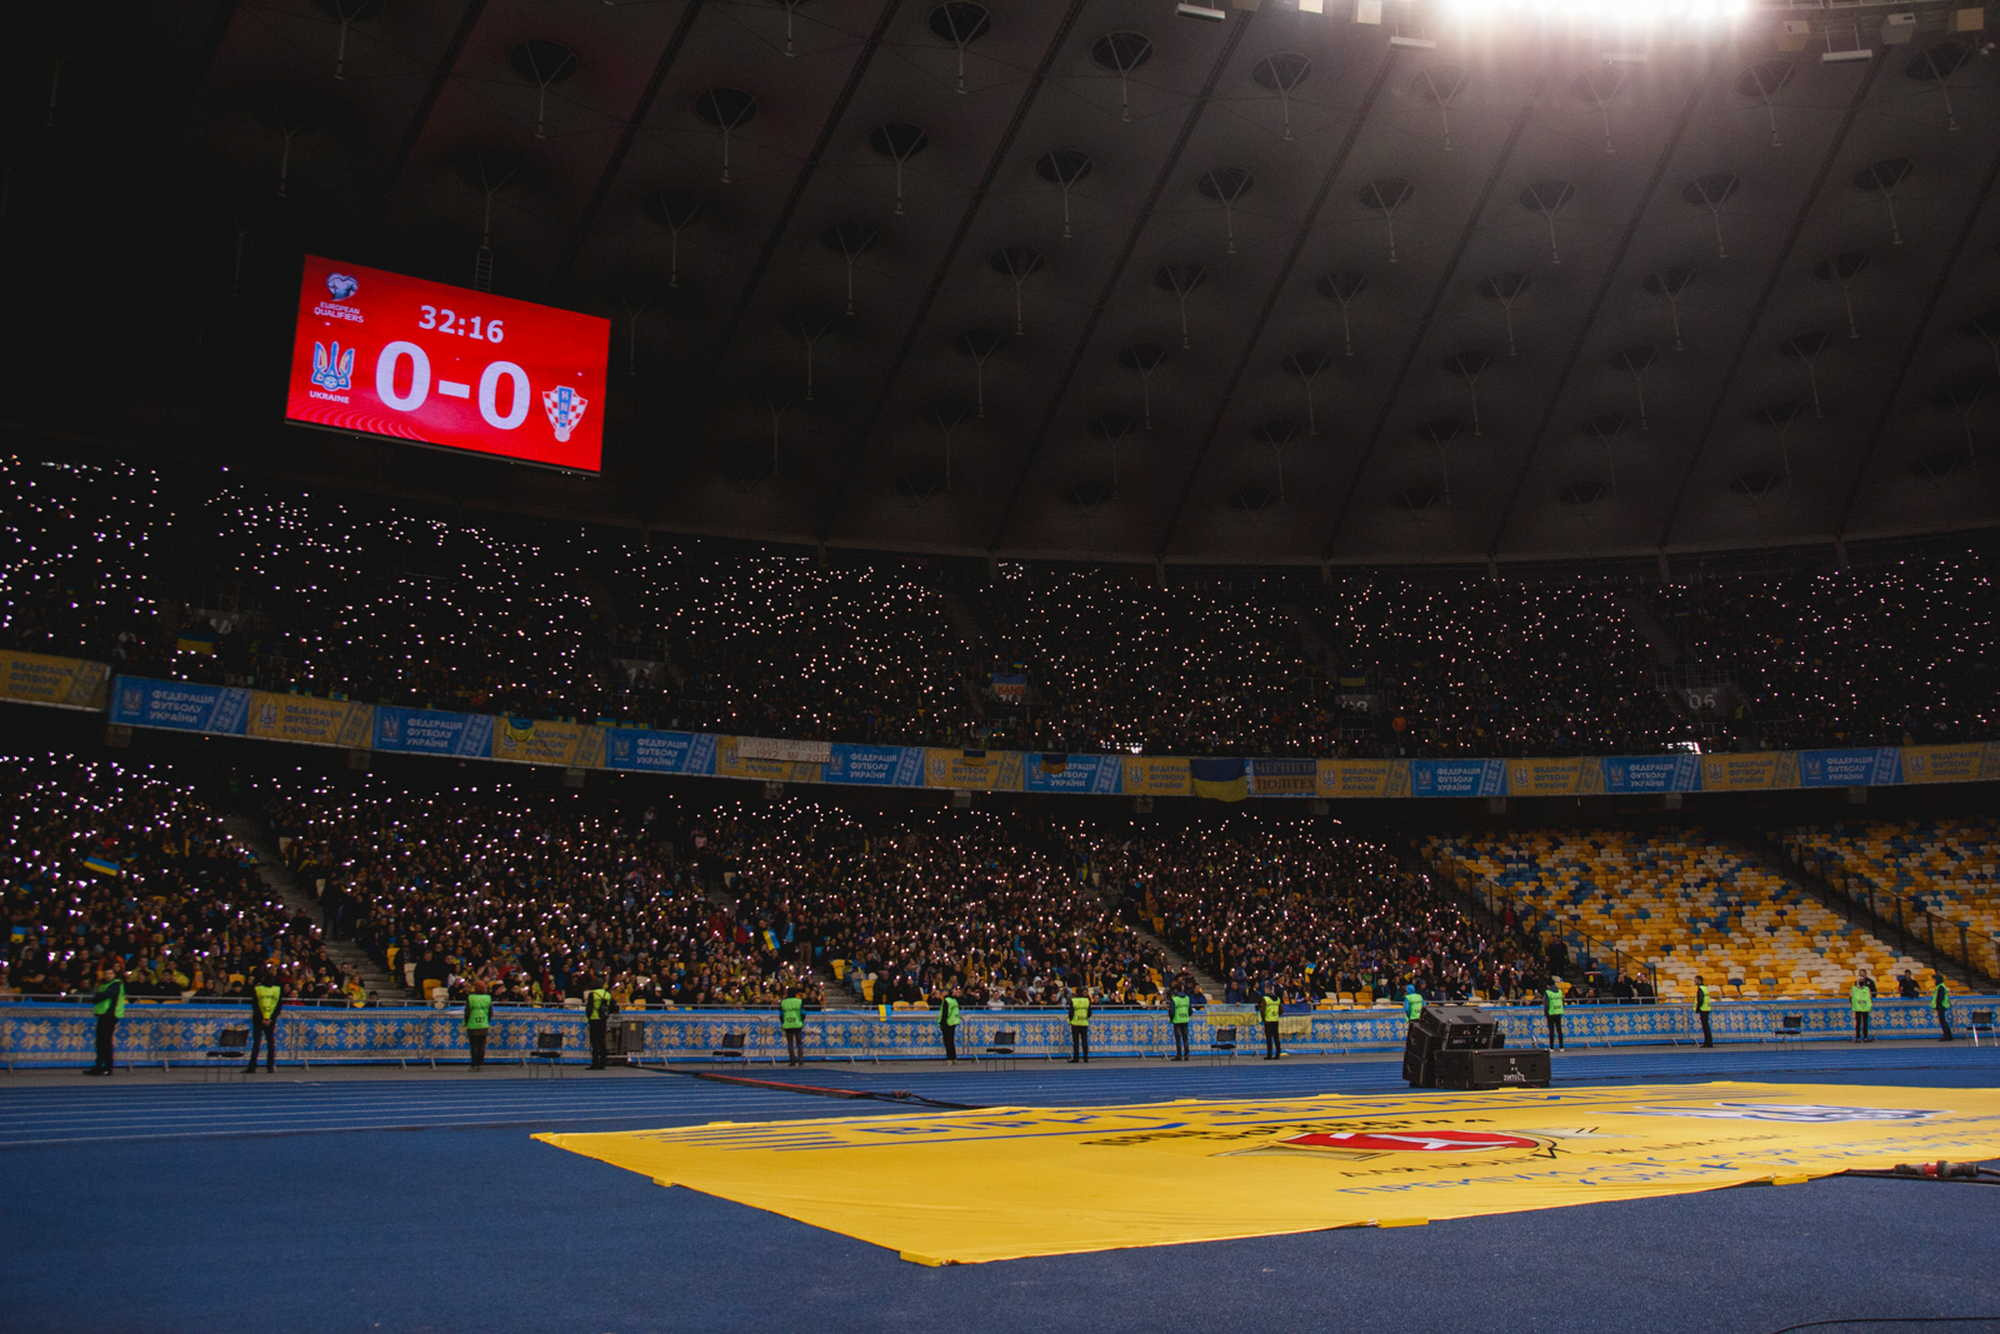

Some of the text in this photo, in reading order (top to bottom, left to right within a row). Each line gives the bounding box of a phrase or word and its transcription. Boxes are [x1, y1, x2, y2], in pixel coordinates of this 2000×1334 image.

[313, 306, 365, 323] QUALIFIERS
[320, 301, 361, 315] EUROPEAN
[418, 304, 505, 344] 32:16
[309, 390, 350, 404] UKRAINE
